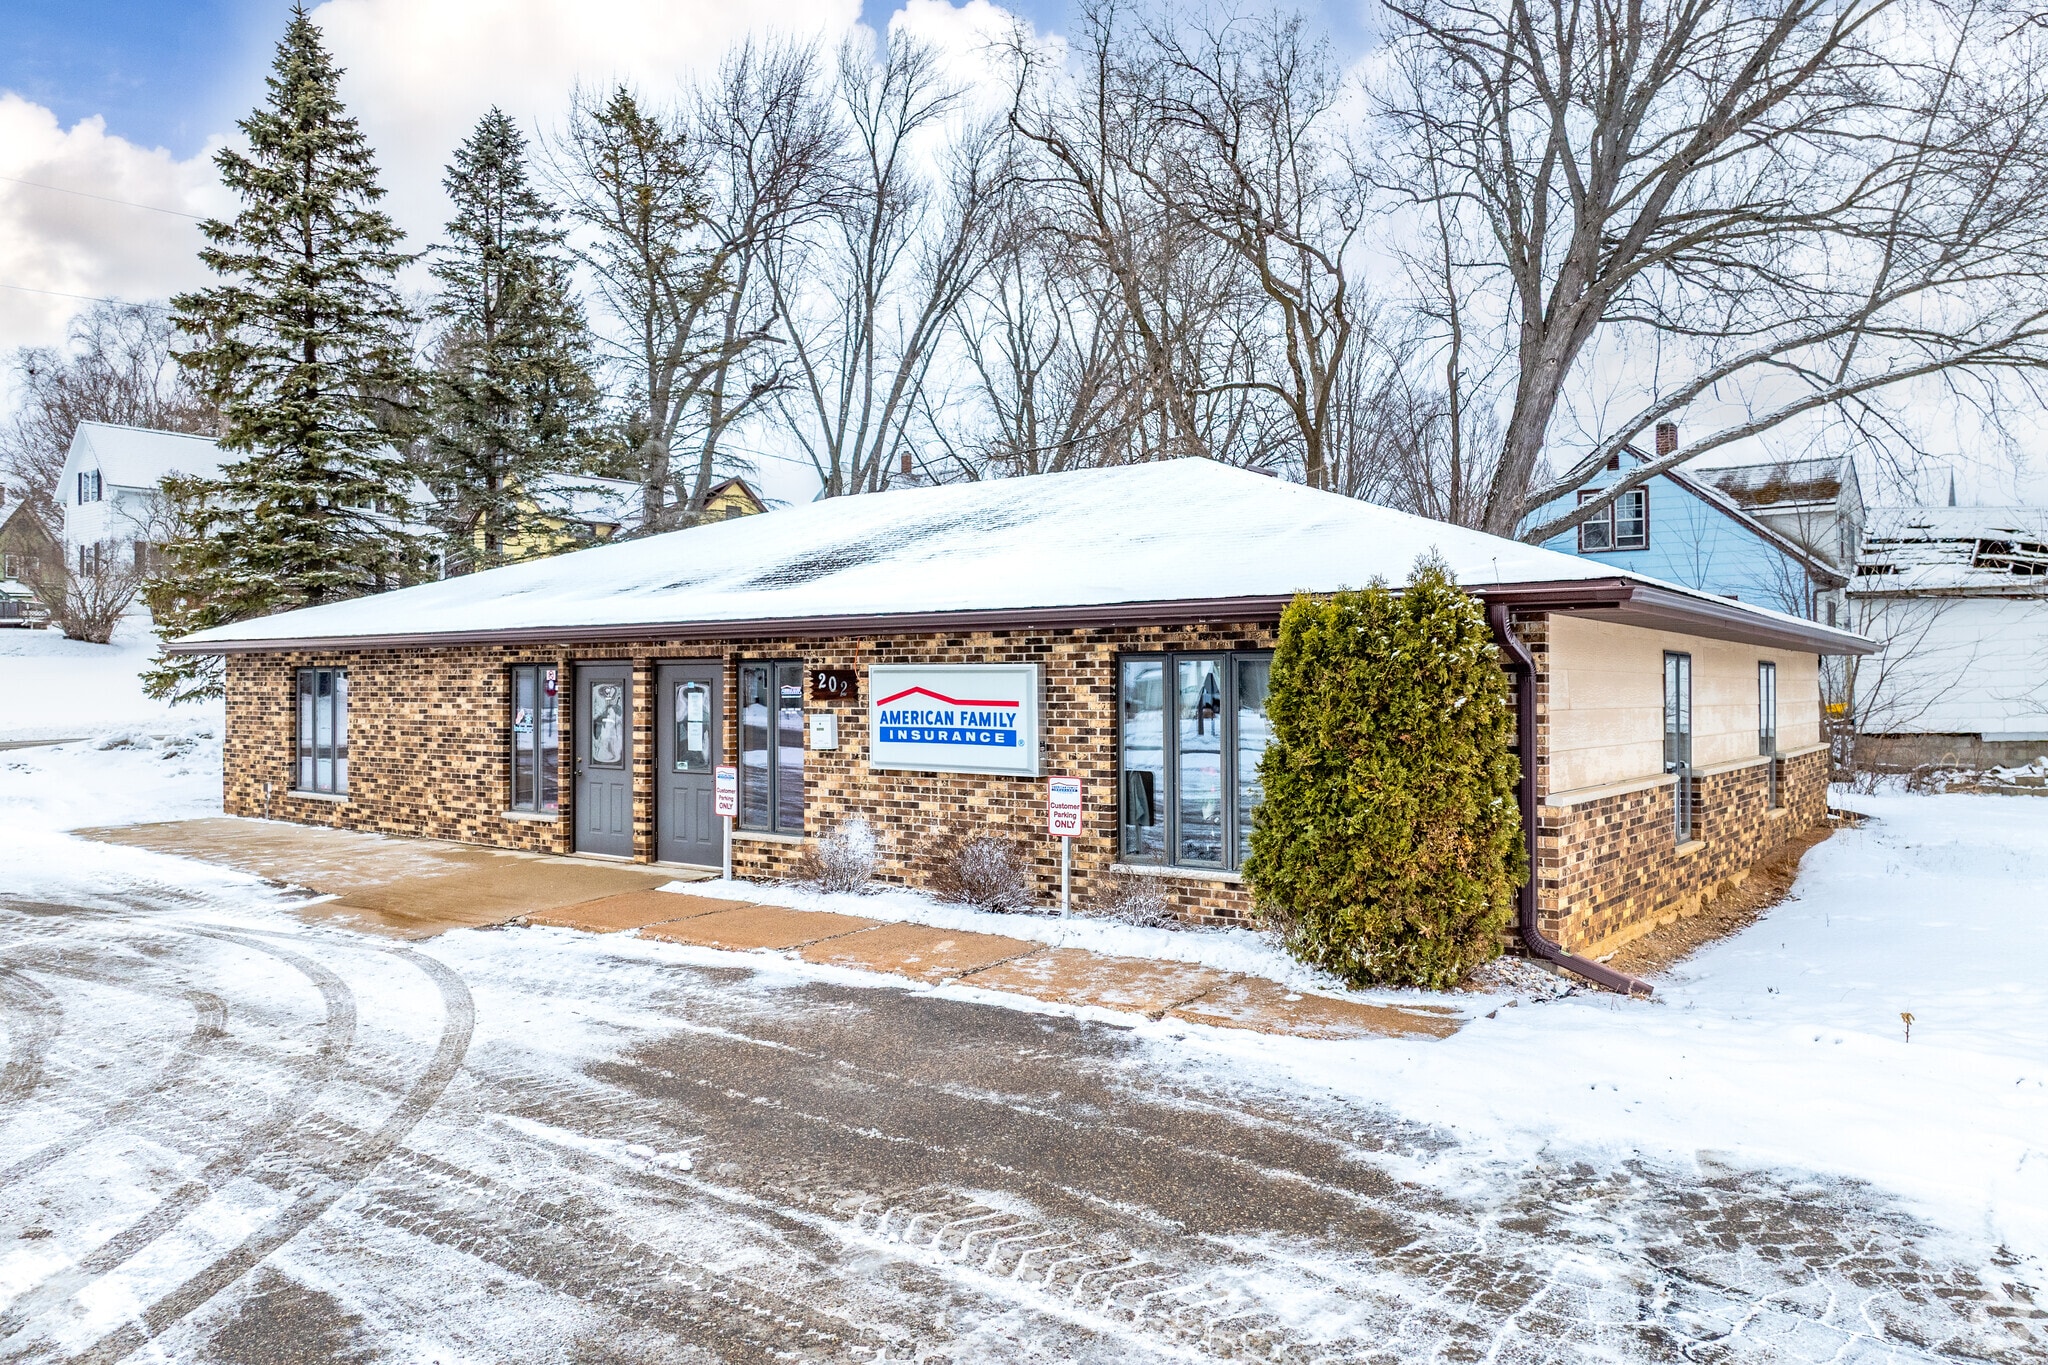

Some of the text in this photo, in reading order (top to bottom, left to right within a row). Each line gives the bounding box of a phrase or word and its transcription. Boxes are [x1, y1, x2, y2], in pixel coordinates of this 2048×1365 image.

[818, 672, 848, 697] 202
[879, 710, 1017, 728] AMERICAN FAMILY
[889, 729, 1005, 743] INSURANCE
[718, 794, 734, 802] Parking
[718, 802, 733, 810] ONLY
[1050, 801, 1080, 810] Customer
[1053, 811, 1077, 820] Parking
[1054, 820, 1076, 828] ONLY
